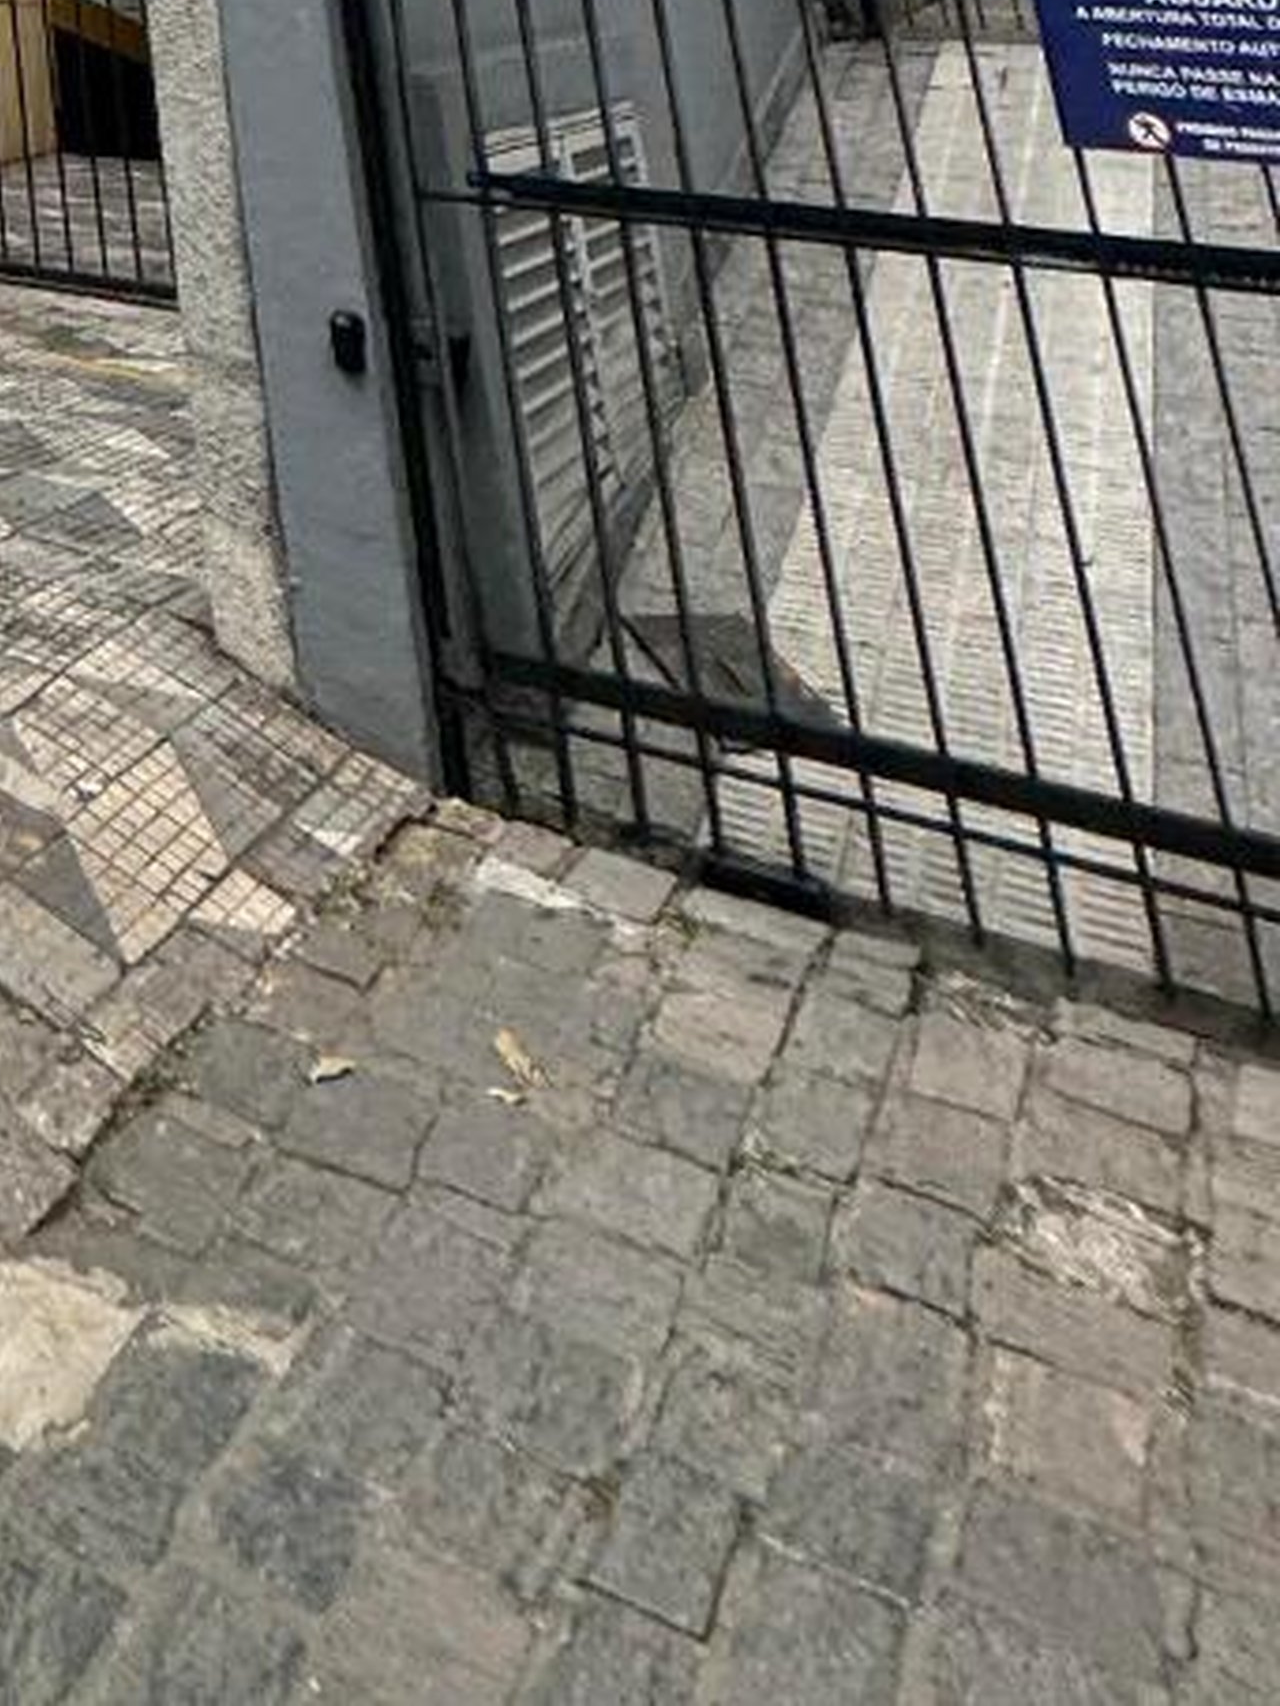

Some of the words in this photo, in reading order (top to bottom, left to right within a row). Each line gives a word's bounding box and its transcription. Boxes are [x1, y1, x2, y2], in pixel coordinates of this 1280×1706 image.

[1075, 5, 1089, 20] A
[1198, 11, 1264, 30] TOTAL
[1220, 86, 1280, 106] ESMA
